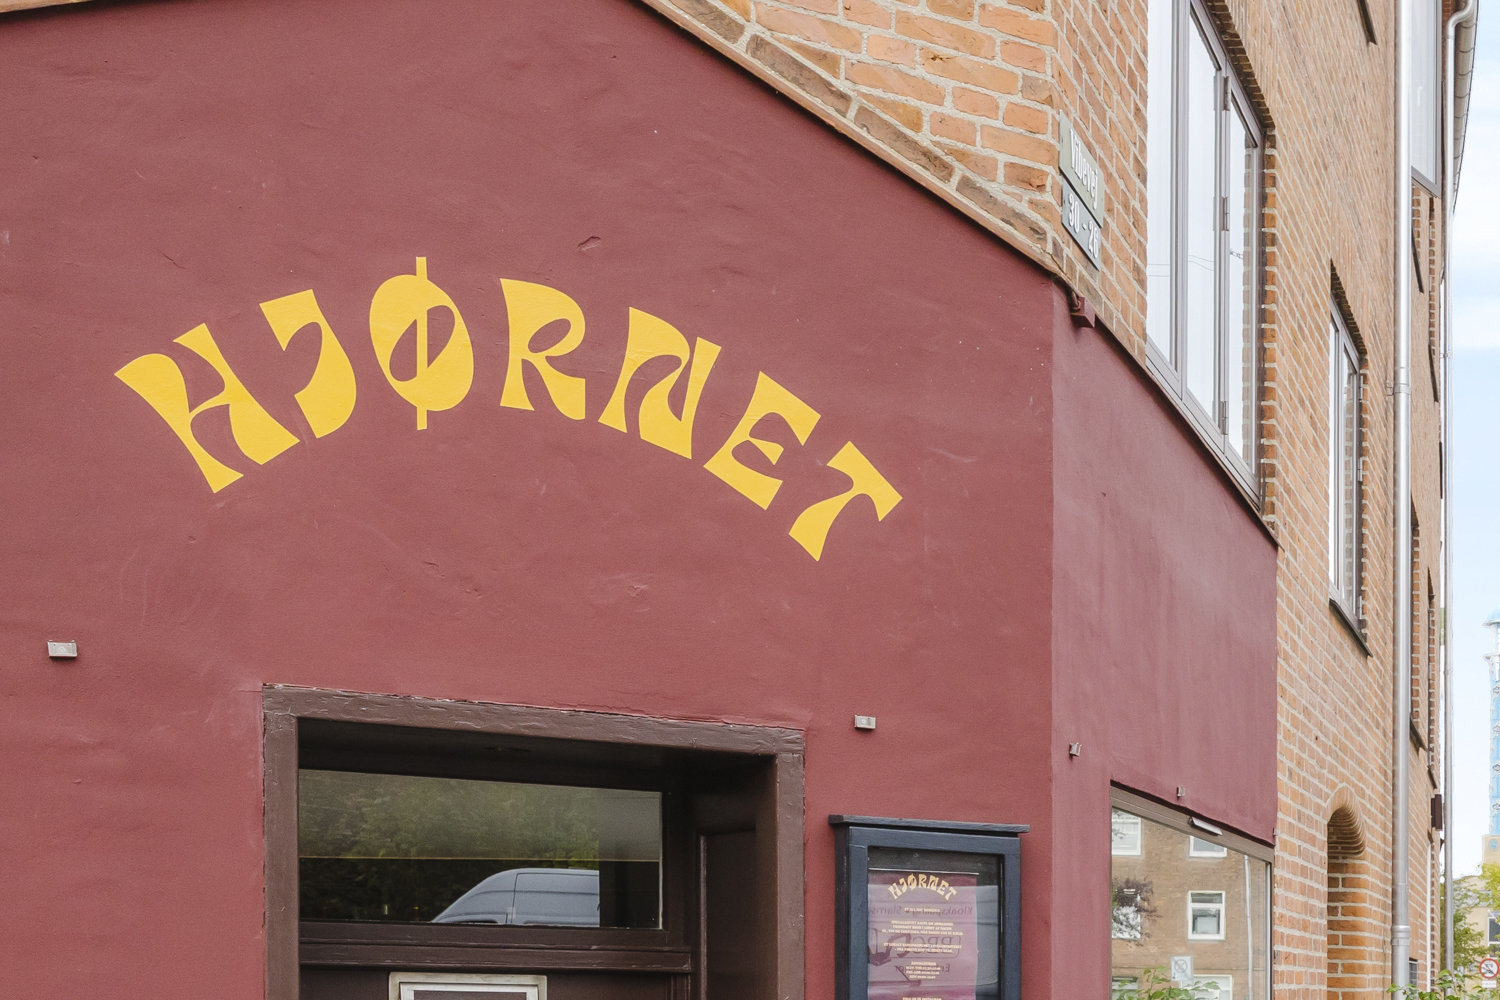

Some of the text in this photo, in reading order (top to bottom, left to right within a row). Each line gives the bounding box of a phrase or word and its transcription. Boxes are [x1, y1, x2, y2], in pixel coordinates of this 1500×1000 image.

[1070, 128, 1099, 210] Vibevej
[1068, 193, 1080, 233] 30
[113, 256, 903, 562] HJØRNET
[888, 873, 957, 900] HJØRNET
